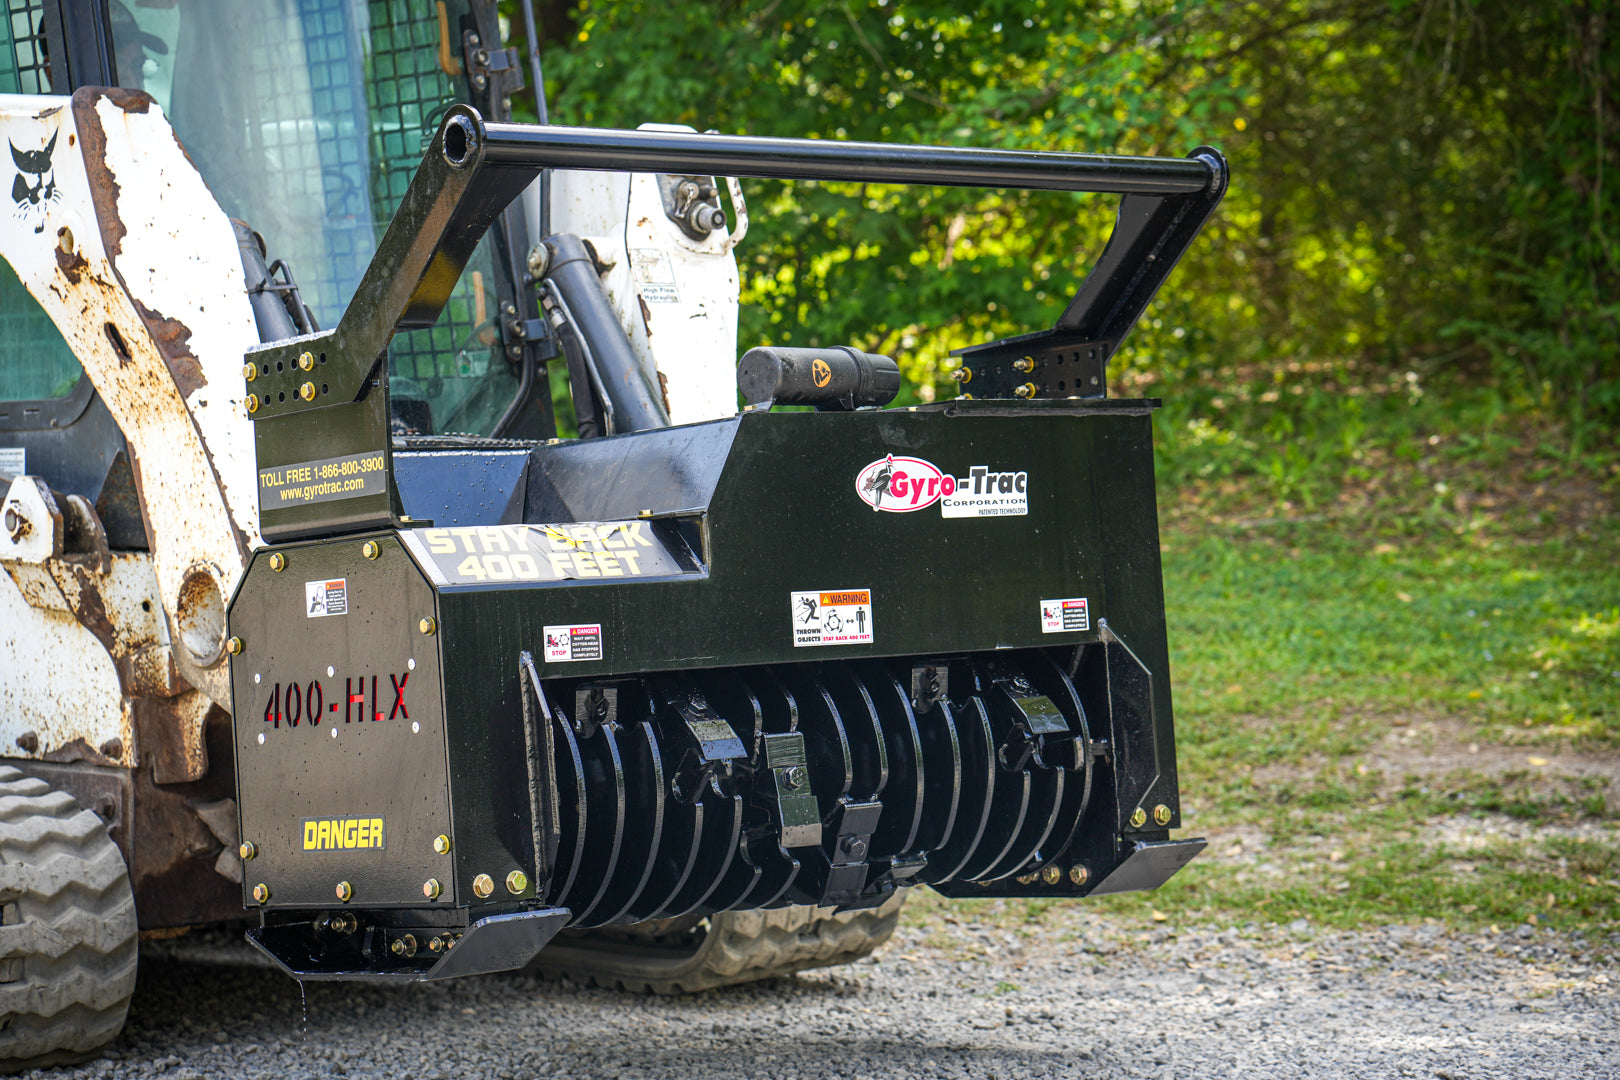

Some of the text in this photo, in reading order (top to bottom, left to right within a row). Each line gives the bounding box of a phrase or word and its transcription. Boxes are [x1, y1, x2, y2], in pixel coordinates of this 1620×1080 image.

[260, 456, 384, 488] TOLL FREE 1-866-800-3900
[890, 468, 1026, 505] Gyro-Trac
[280, 478, 364, 501] www.gyrotrac.com
[942, 498, 1026, 507] CORPORATION
[999, 507, 1026, 515] TECHNOLOGY
[425, 526, 529, 554] STAY
[457, 549, 642, 581] 400 FEET
[829, 593, 868, 604] WARNING
[264, 672, 409, 729] 400-HLX
[303, 818, 384, 850] DANGER
